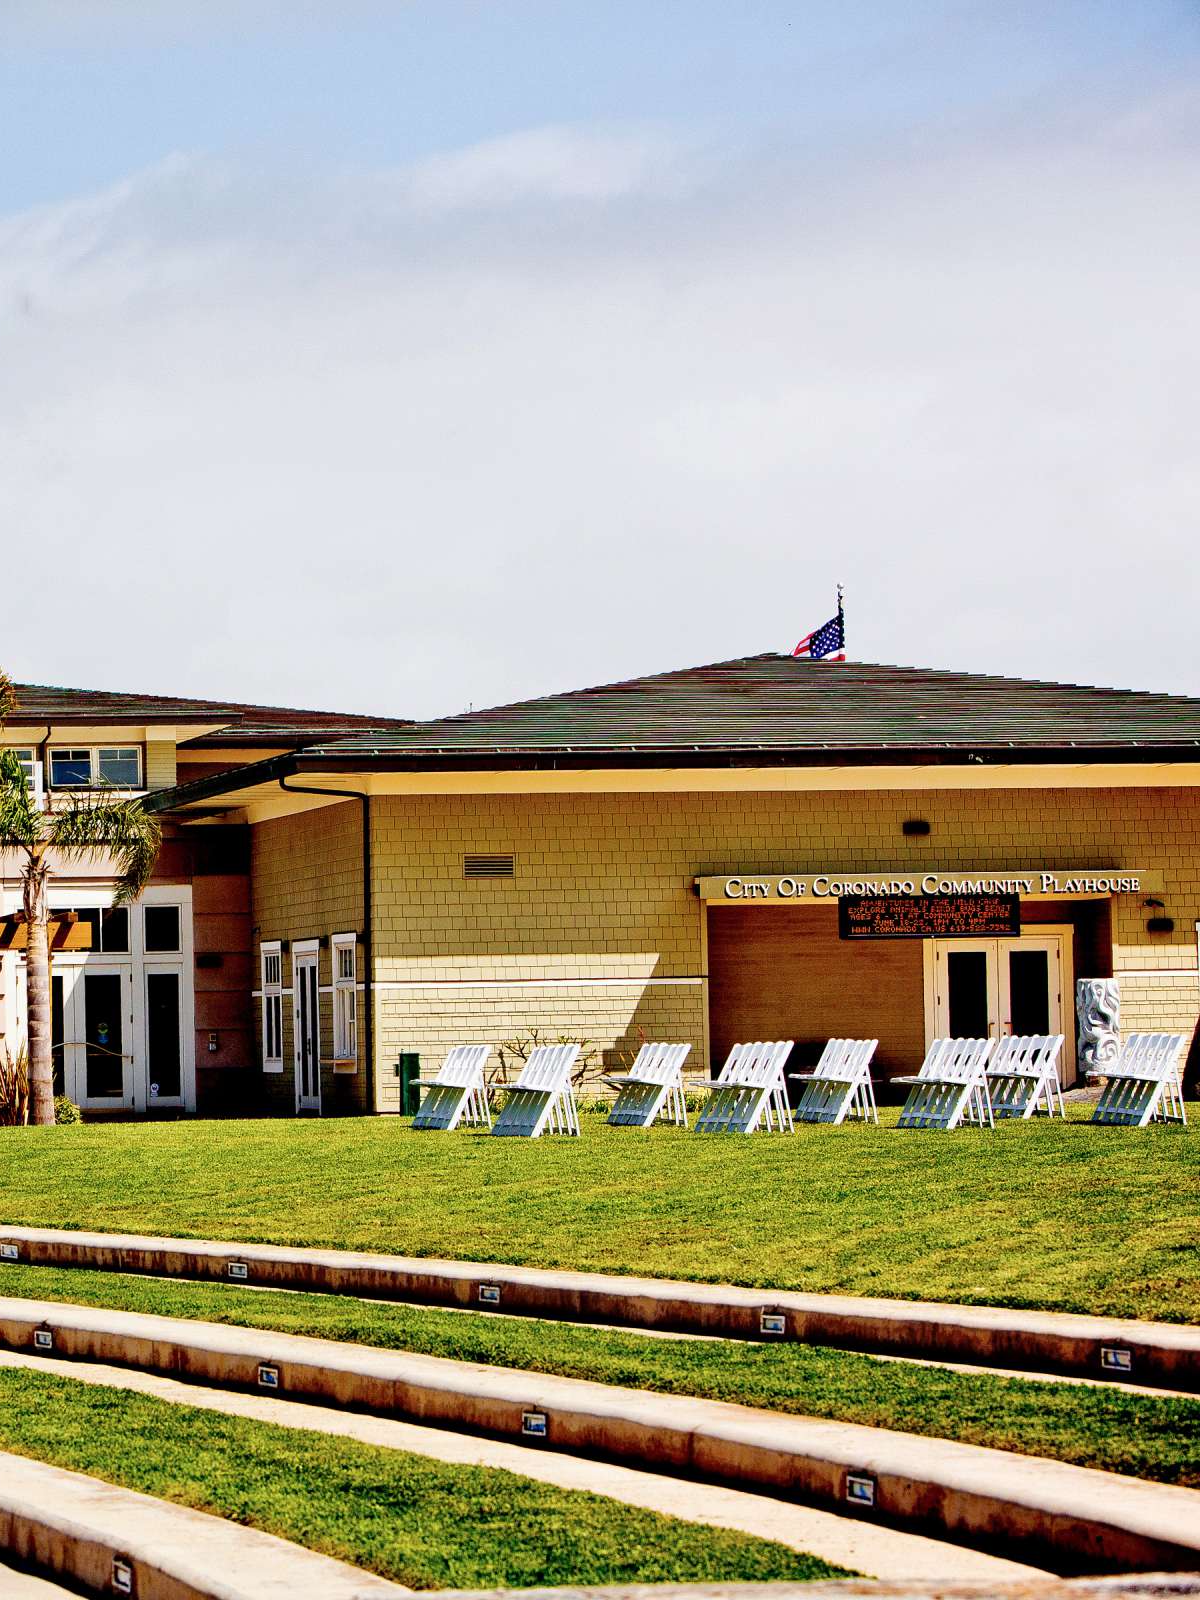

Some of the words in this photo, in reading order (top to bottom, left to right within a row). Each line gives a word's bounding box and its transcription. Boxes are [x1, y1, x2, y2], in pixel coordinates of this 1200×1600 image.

[725, 879, 770, 897] CITY
[778, 877, 806, 896] OF
[813, 877, 914, 895] CORONADO
[922, 875, 1033, 894] COMMUNITY
[1040, 873, 1140, 892] PLAYHOUSE
